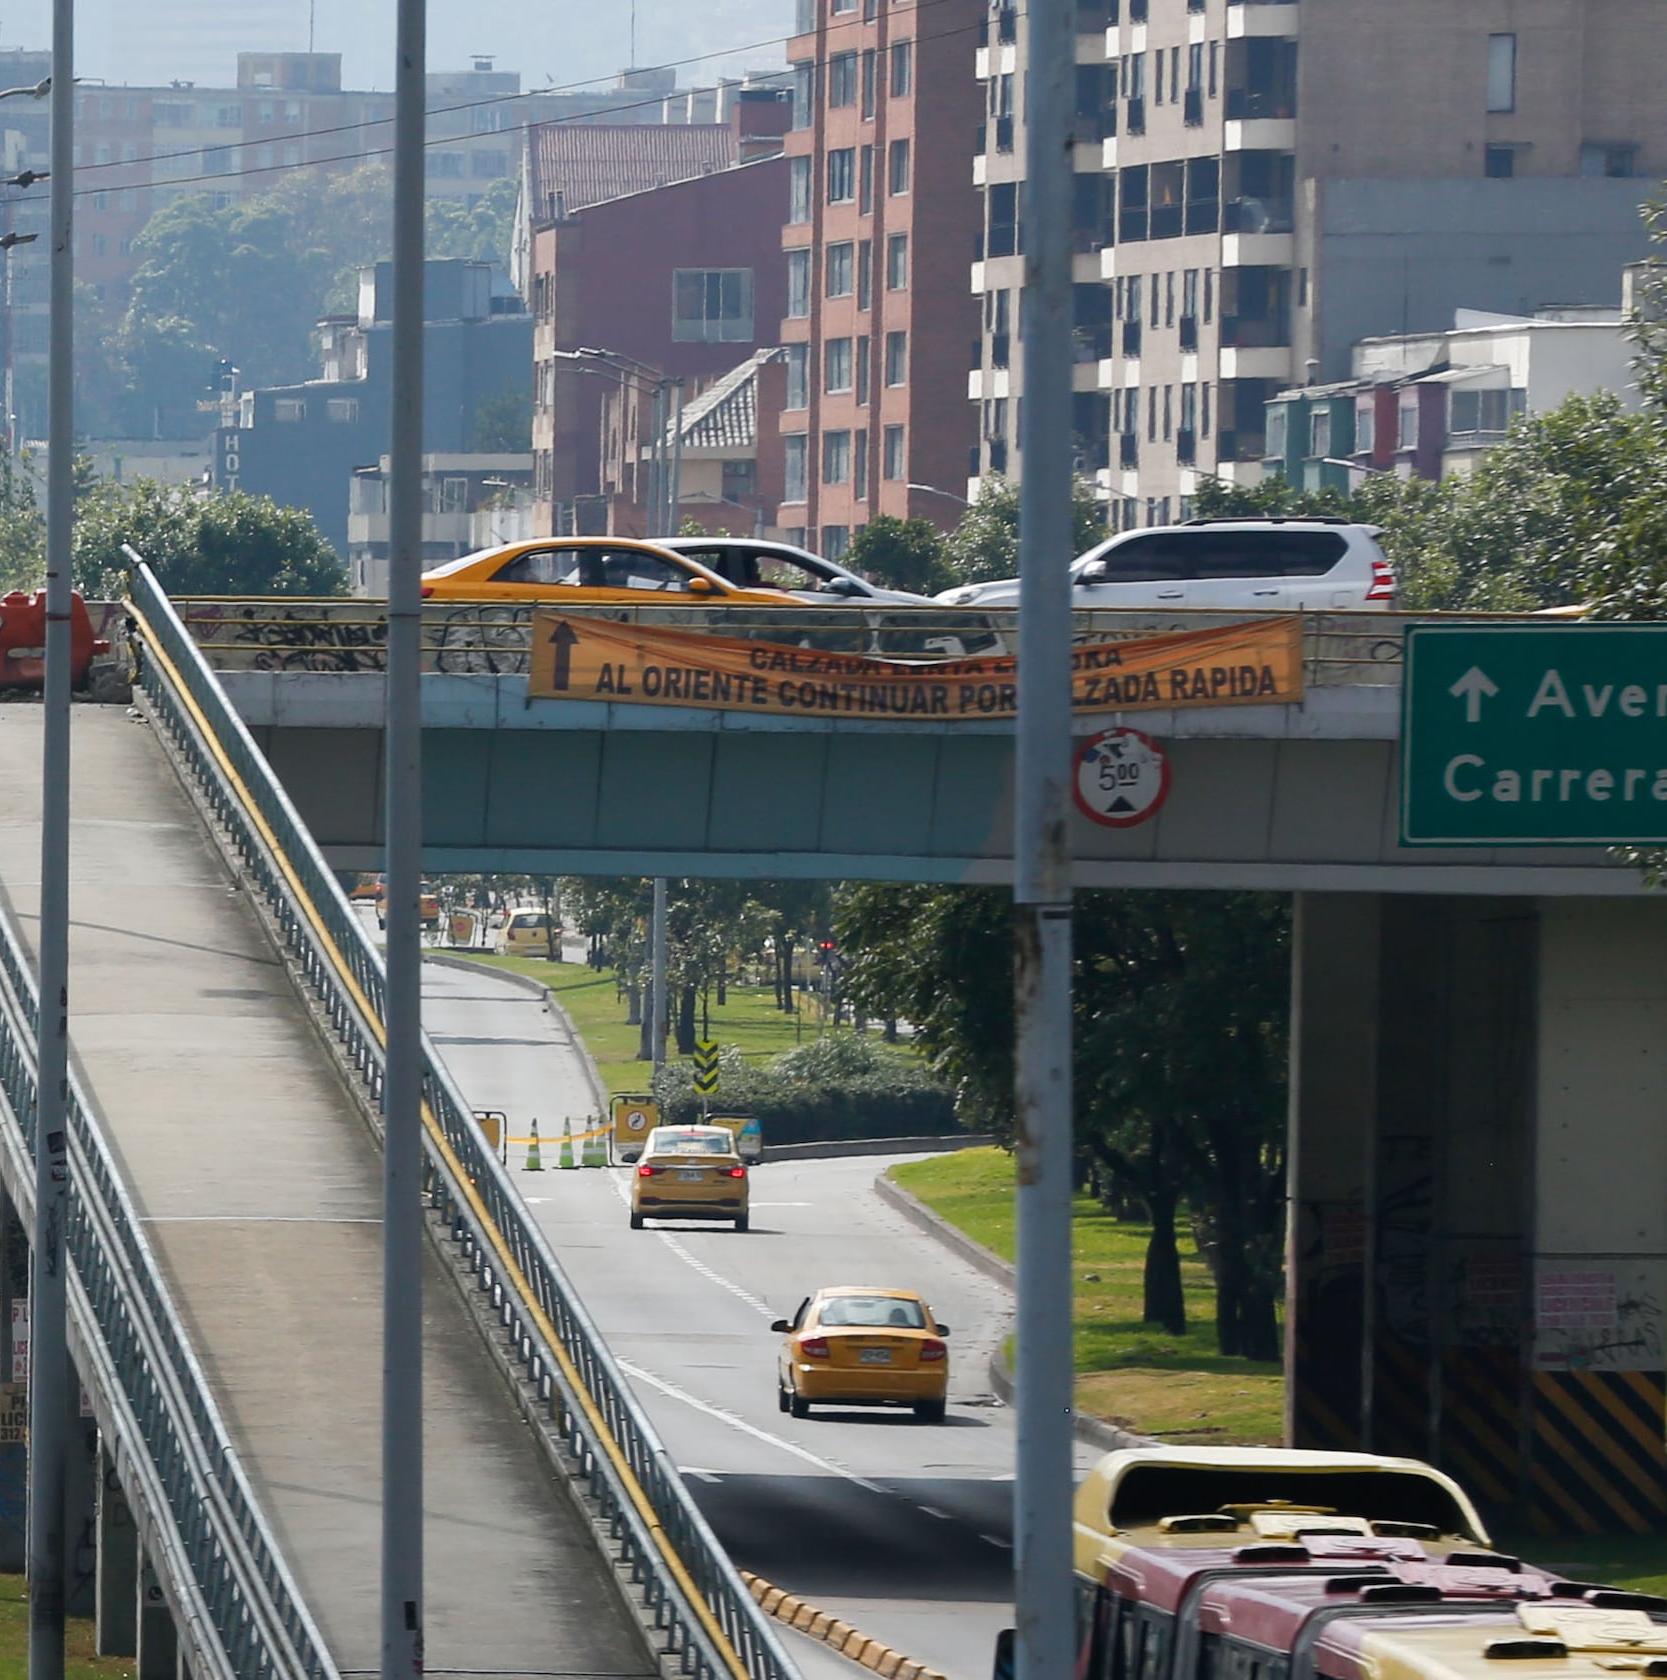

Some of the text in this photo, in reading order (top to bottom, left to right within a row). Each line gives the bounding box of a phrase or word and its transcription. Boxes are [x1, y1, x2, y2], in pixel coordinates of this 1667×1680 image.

[595, 662, 633, 695] AL
[642, 664, 767, 705] ORIENTE
[777, 679, 949, 715] CONTINUAR
[959, 683, 1016, 714] POR
[1170, 664, 1278, 701] RAPIDA
